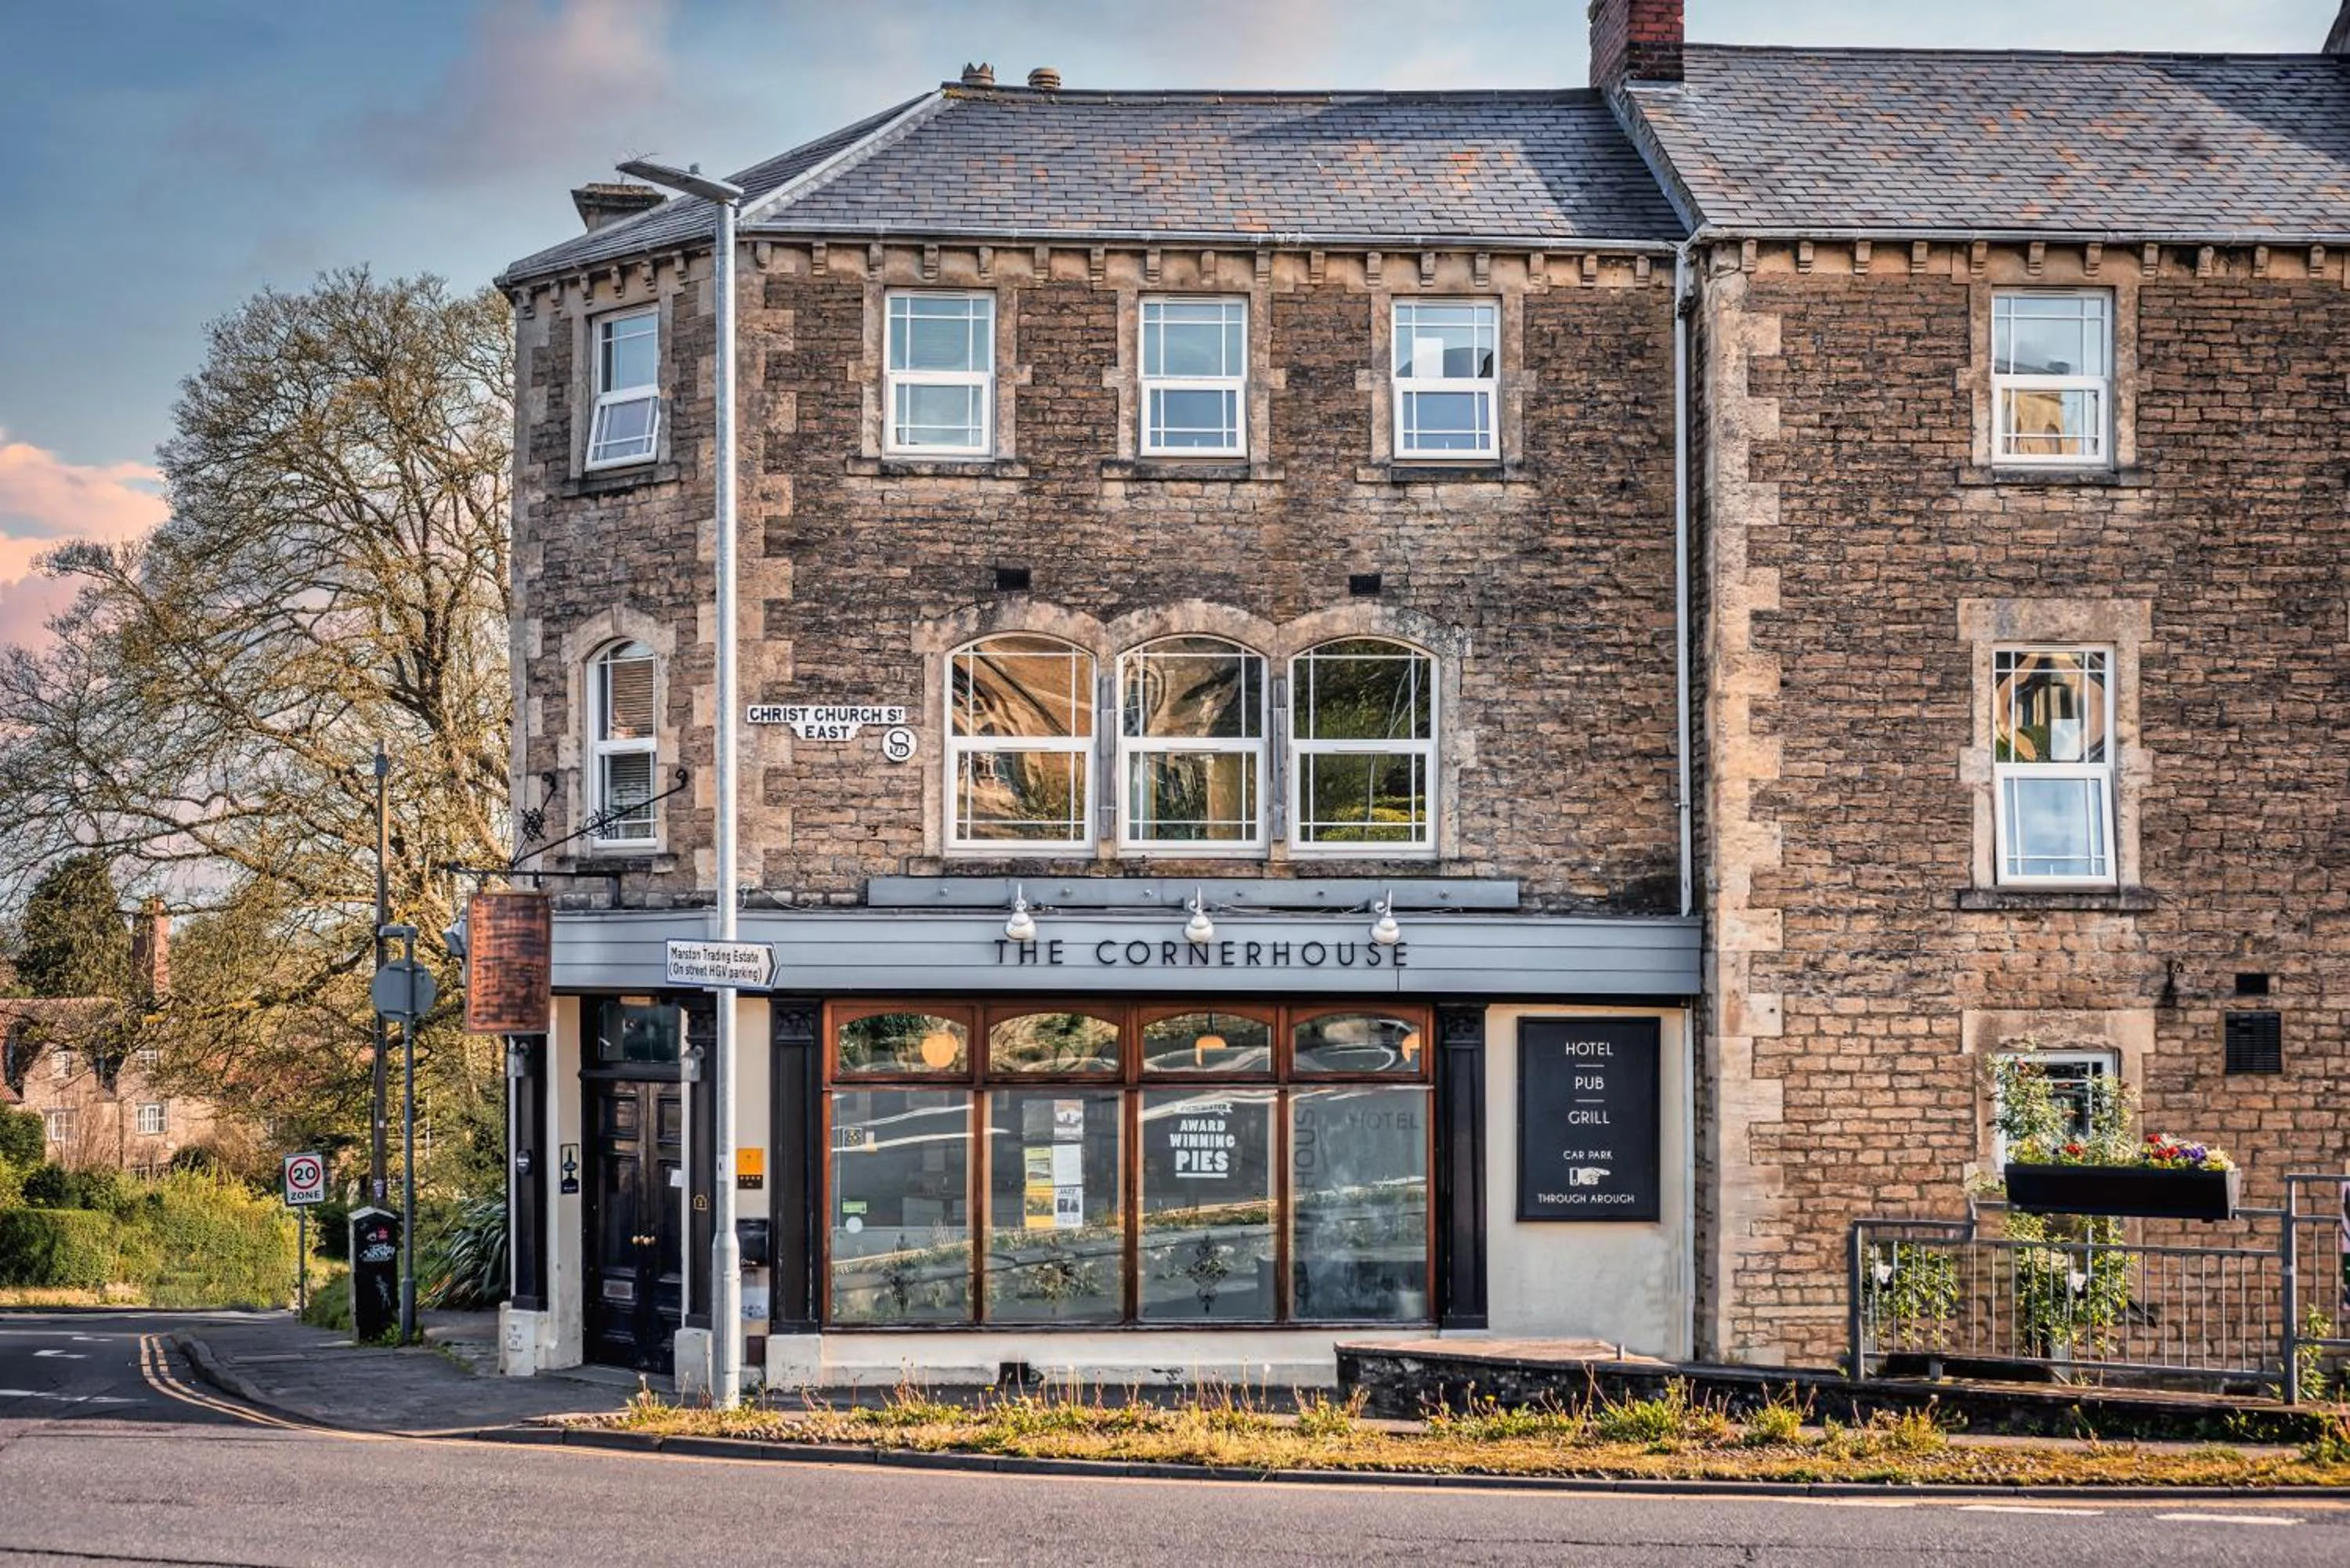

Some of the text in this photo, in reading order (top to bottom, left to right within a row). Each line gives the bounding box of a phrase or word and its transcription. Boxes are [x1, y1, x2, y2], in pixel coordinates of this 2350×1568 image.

[750, 707, 808, 721] CHRIST
[814, 708, 882, 722] CHURCH
[804, 725, 850, 739] EAST
[671, 947, 759, 964] Marston Trading Estate
[994, 940, 1408, 967] THE CORNERHOUSE
[668, 962, 762, 983] (On street HGV parking)
[1566, 1042, 1614, 1056] HOTEL
[1574, 1076, 1604, 1090] PUB
[1349, 1111, 1419, 1130] HOTEL
[1567, 1111, 1611, 1125] GRILL
[1179, 1118, 1226, 1133] AWARD
[1170, 1133, 1236, 1149] WINNING
[1175, 1150, 1229, 1172] PIES
[1563, 1150, 1613, 1160] CAR PARK
[294, 1166, 316, 1180] 20
[291, 1190, 320, 1201] ZONE
[1537, 1193, 1586, 1204] THROUGH
